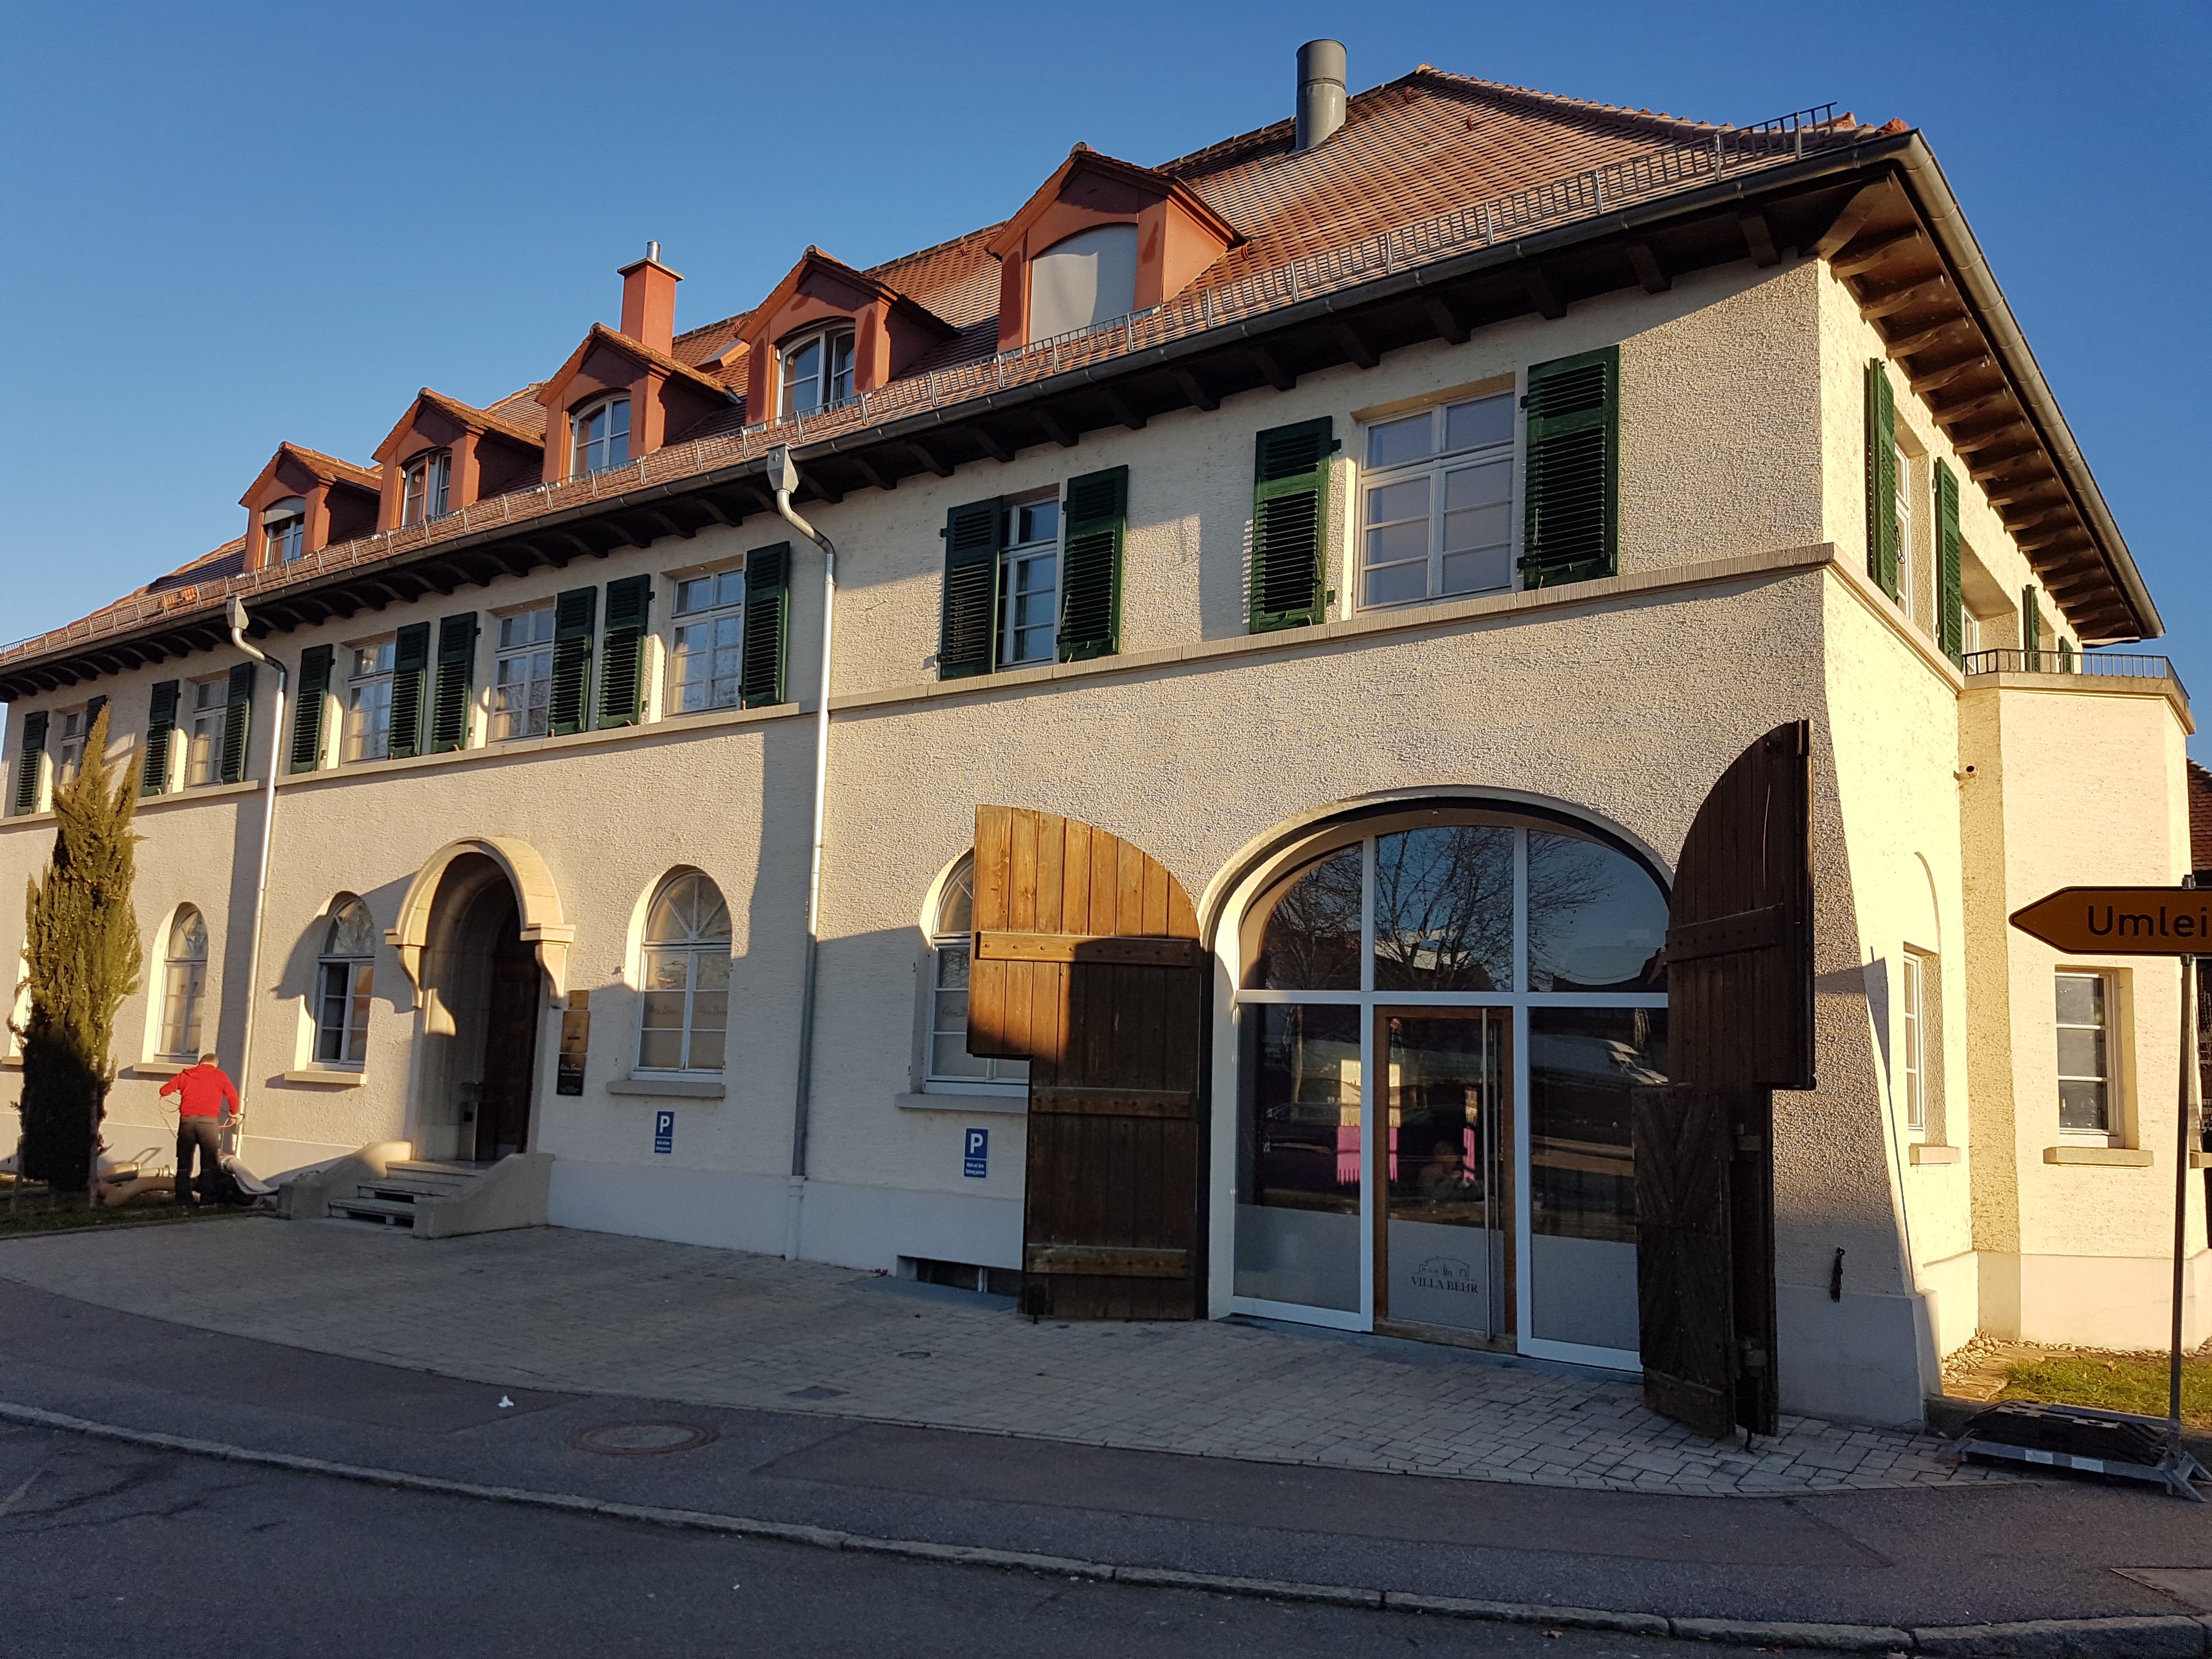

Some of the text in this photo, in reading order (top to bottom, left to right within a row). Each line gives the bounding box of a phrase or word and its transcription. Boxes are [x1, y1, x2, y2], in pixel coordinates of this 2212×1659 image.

[2087, 905, 2208, 938] Umlei
[659, 1115, 670, 1133] P
[970, 1132, 984, 1154] P
[1411, 1276, 1479, 1294] VILLA BEHR
